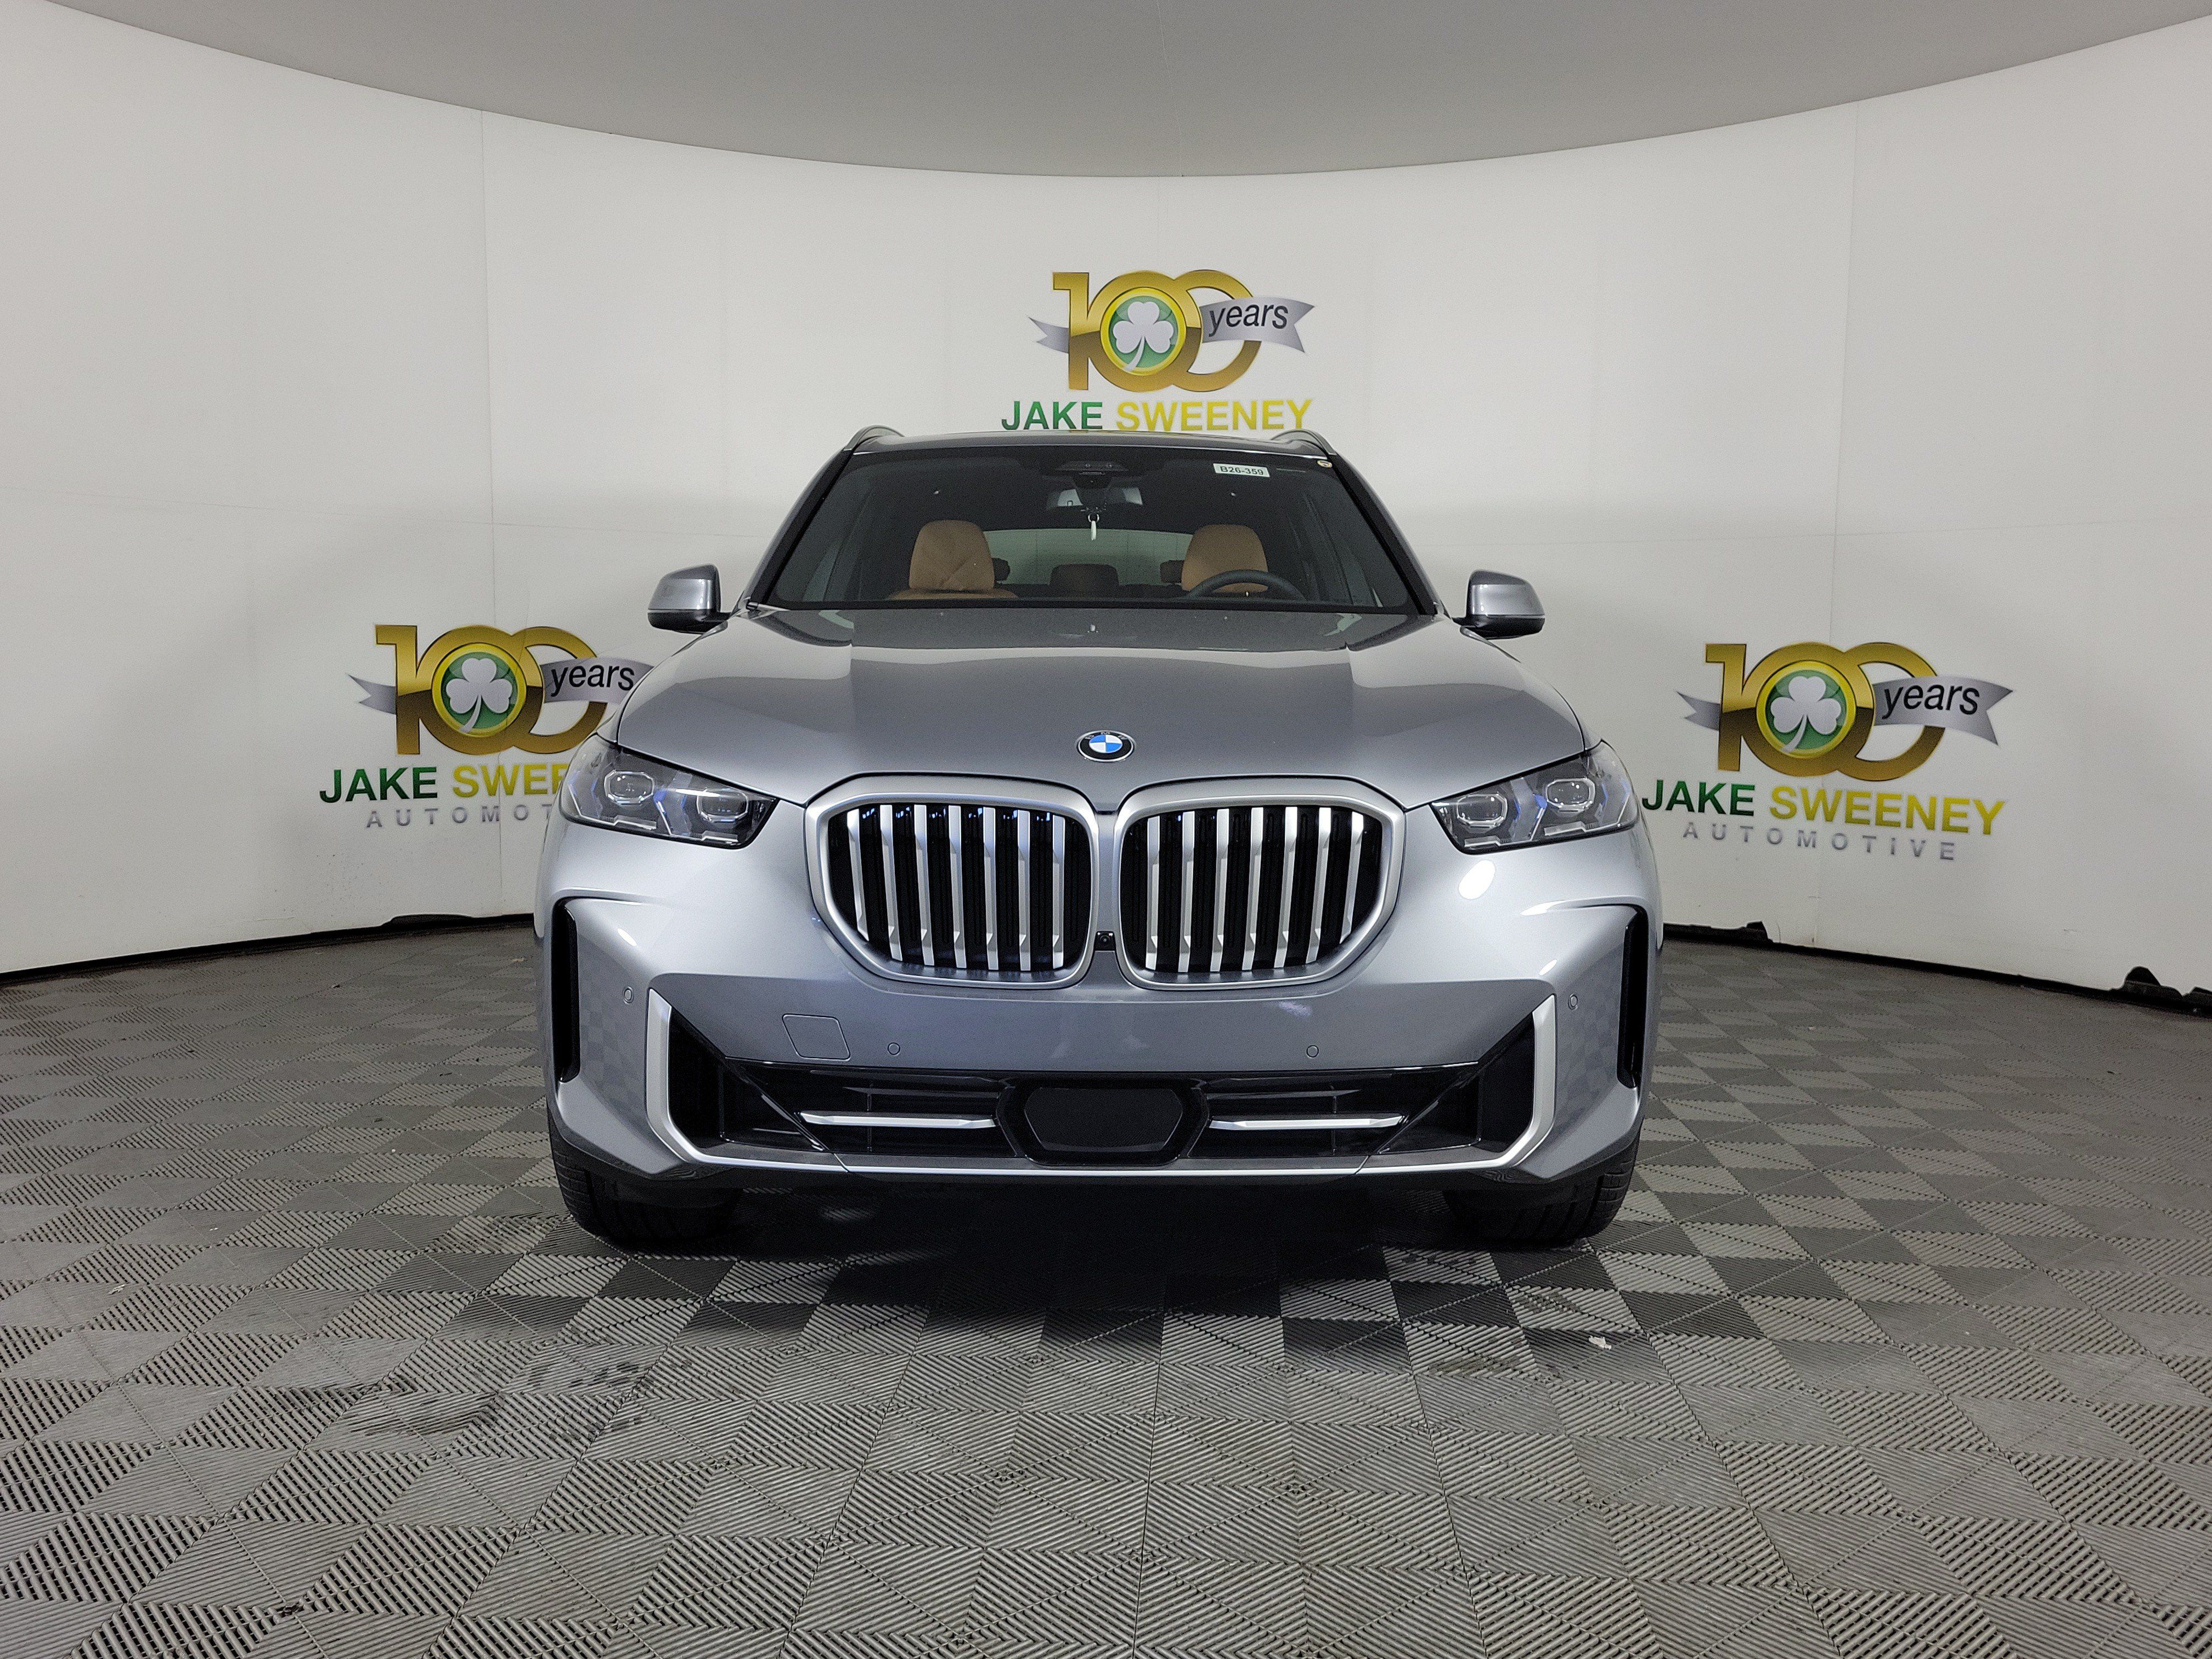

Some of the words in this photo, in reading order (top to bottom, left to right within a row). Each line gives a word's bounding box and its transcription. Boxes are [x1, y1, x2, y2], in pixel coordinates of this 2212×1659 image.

[1052, 269, 1262, 393] 100
[1209, 304, 1289, 337] years
[1001, 400, 1103, 430] JAKE
[1116, 399, 1313, 432] SWEENEY
[1220, 466, 1264, 476] B26-359
[375, 624, 608, 755] 100
[550, 662, 635, 697] years
[1705, 641, 1946, 782] 100
[1881, 684, 1980, 720] years
[319, 766, 438, 803] JAKE
[452, 763, 569, 798] SWEE
[366, 803, 552, 829] AUTOMOT
[1641, 778, 1756, 816] JAKE
[1770, 786, 2006, 836] SWEENEY
[1682, 821, 1956, 861] AUTOMOTIVE
